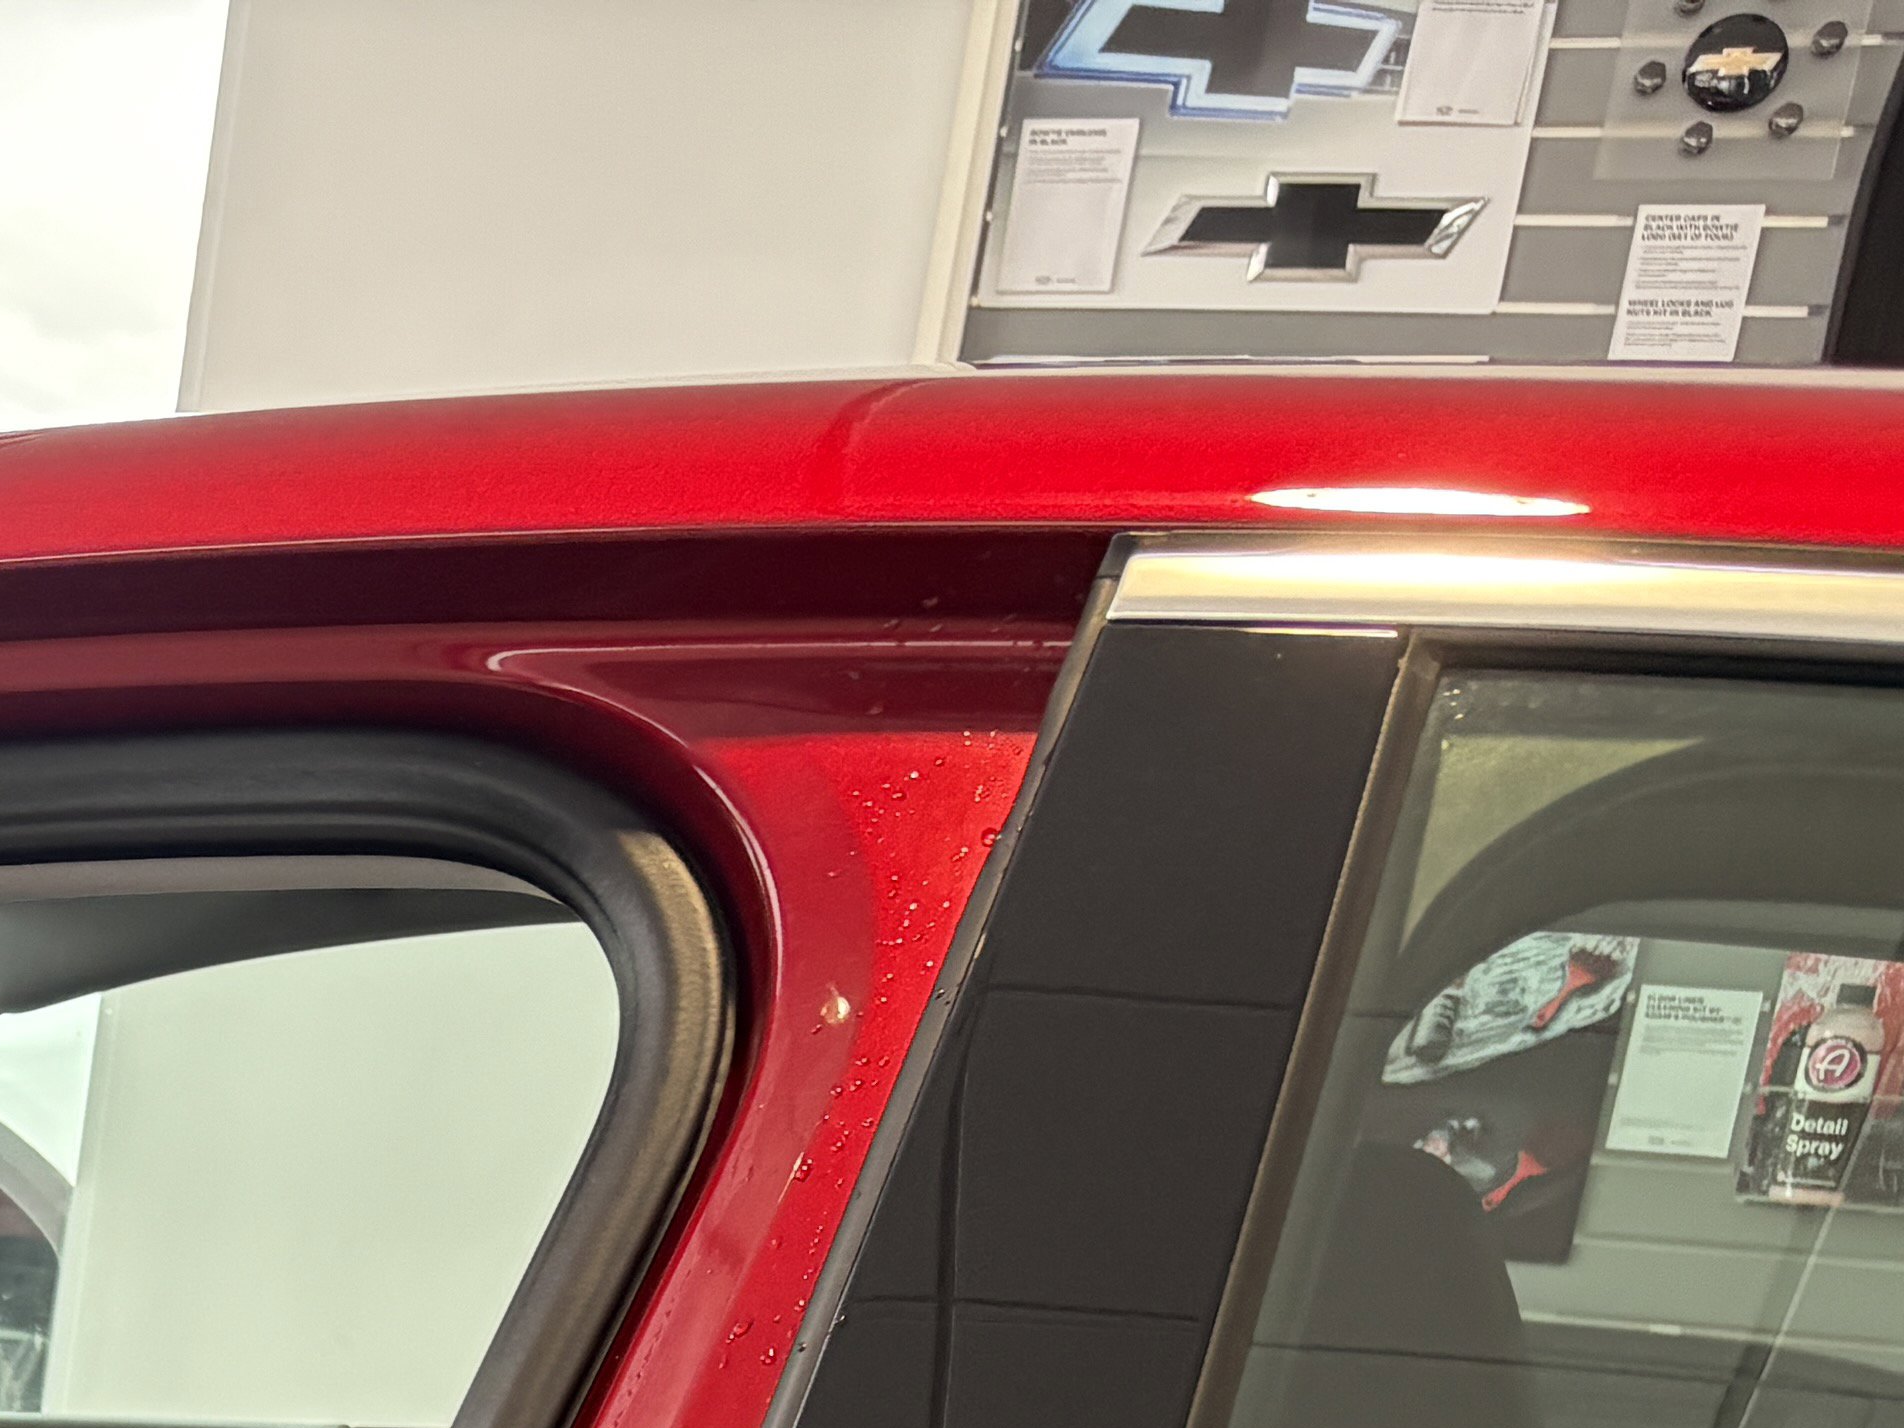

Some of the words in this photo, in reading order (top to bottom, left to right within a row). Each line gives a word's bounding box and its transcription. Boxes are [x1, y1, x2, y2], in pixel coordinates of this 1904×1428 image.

[1645, 214, 1682, 223] CENTER
[1684, 214, 1708, 223] CAPS
[1711, 215, 1721, 223] IN
[1643, 223, 1674, 232] BLACK
[1676, 223, 1701, 232] WITH
[1702, 223, 1739, 233] BOWTIE
[1628, 300, 1659, 308] WHEEL
[1662, 300, 1692, 308] LOCKS
[1693, 300, 1714, 309] AND
[1715, 301, 1734, 309] LUG
[1626, 308, 1650, 316] NUTS
[1652, 309, 1667, 317] KIT
[1669, 309, 1680, 317] IN
[1681, 309, 1712, 317] BLACK
[1791, 1113, 1849, 1136] Detail
[1786, 1134, 1844, 1161] Spray
